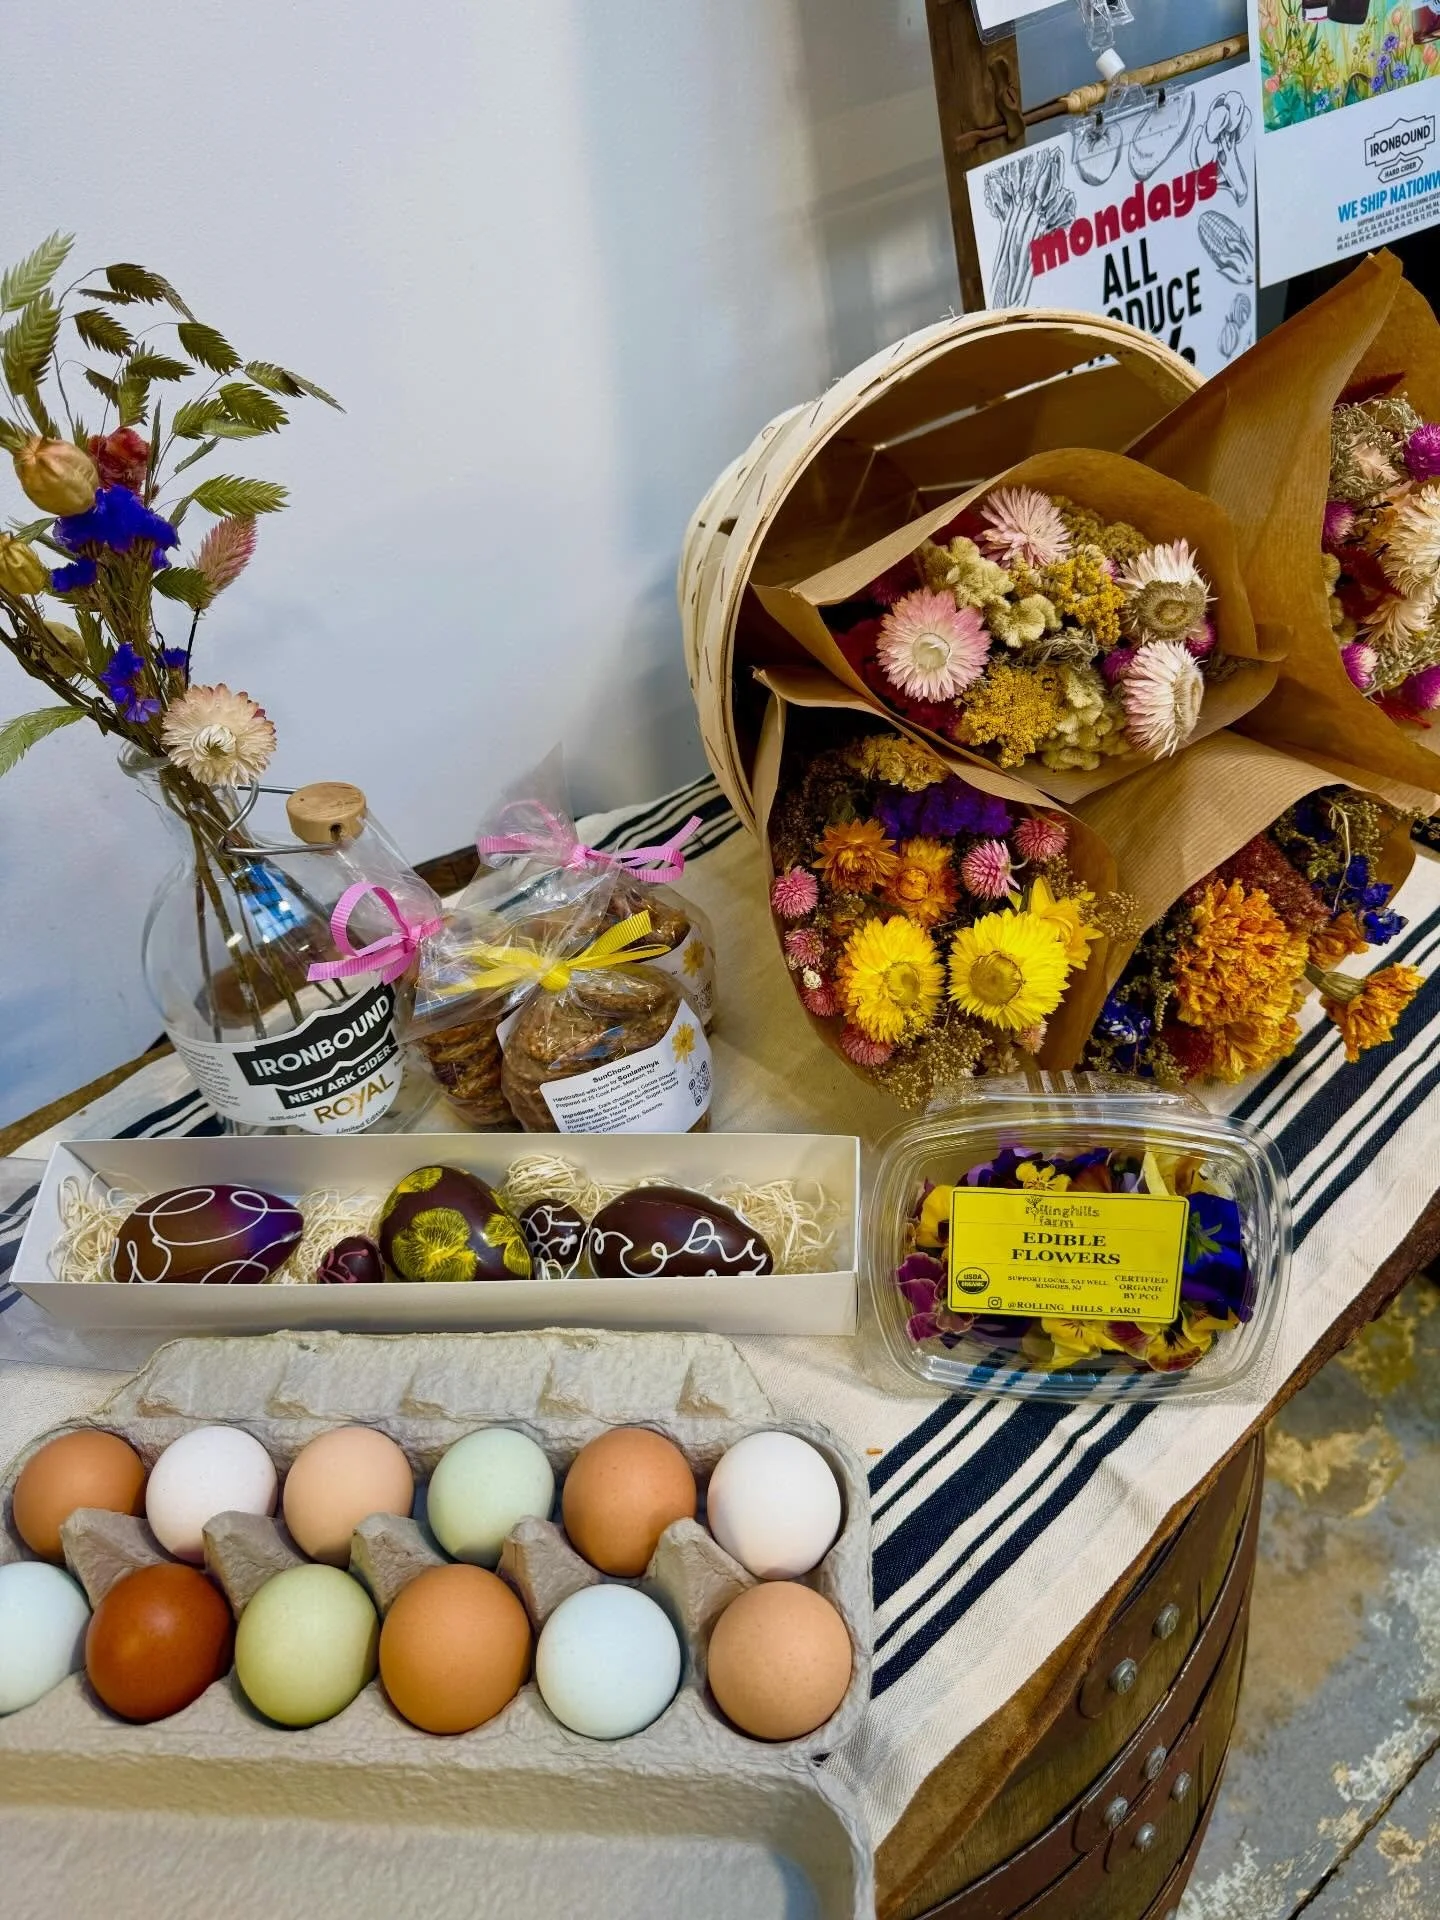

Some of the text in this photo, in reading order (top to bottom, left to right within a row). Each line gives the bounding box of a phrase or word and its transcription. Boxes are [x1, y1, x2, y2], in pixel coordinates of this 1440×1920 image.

[1370, 125, 1430, 157] IRONBOUND
[1384, 161, 1417, 178] HARD CIDER
[1338, 200, 1358, 223] WE
[1360, 188, 1387, 216] SHIP
[1029, 160, 1219, 277] mondays
[1103, 238, 1157, 305] ALL
[251, 995, 390, 1077] IRONBOUND
[288, 1086, 323, 1104] NEW
[327, 1073, 357, 1093] ARK
[357, 1045, 392, 1076] CIDER
[593, 1064, 631, 1083] SunChoco
[313, 1073, 394, 1124] ROYAL
[336, 1104, 388, 1134] Limited Edition
[1040, 1216, 1074, 1228] farm
[1023, 1231, 1106, 1247] EDIBLE
[1012, 1249, 1120, 1264] FLOWERS
[1008, 1275, 1041, 1283] SUPPORT
[1114, 1274, 1168, 1284] CERTIFIED
[1119, 1284, 1163, 1292] ORGANIC
[1123, 1292, 1159, 1301] BY PCO
[1007, 1301, 1141, 1314] @ROLLING HILLS FARM
